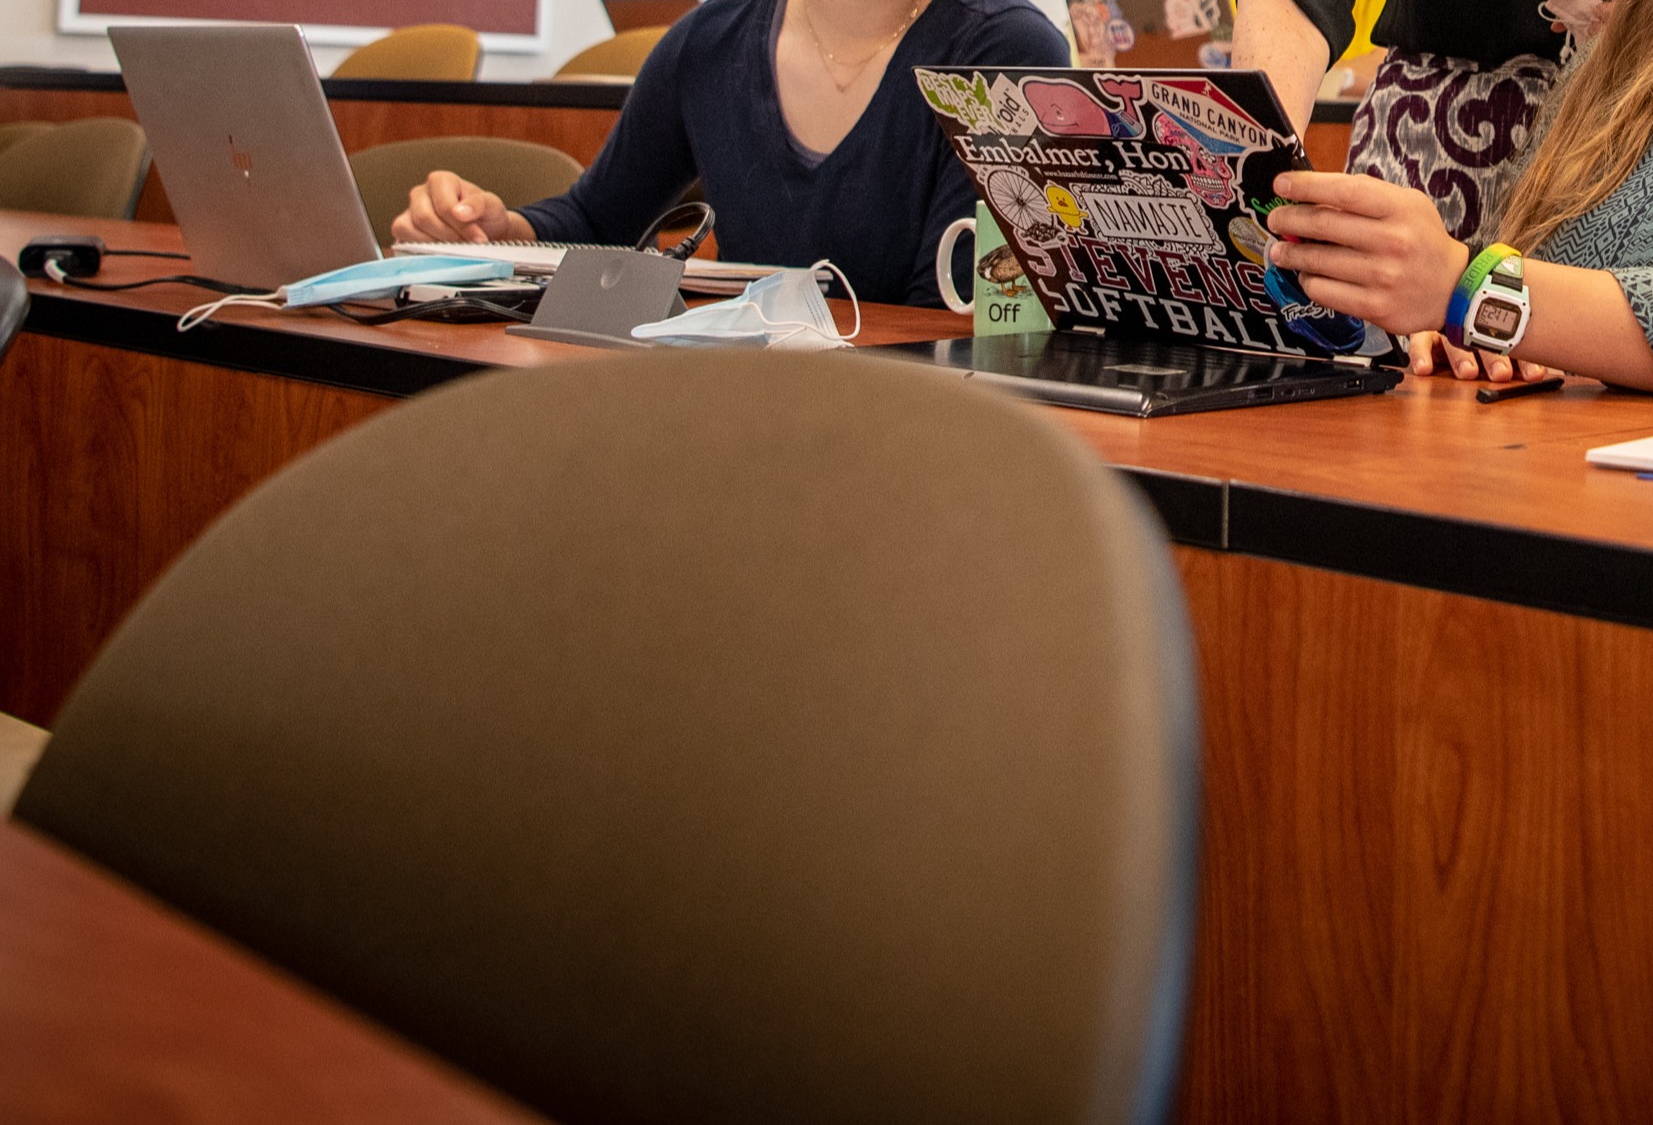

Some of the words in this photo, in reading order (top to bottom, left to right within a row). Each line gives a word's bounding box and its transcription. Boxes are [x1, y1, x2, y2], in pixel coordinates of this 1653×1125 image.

[921, 74, 956, 92] BEST
[937, 87, 981, 106] MAPS
[958, 103, 996, 125] EVER
[1151, 82, 1201, 118] GRAND
[1207, 107, 1268, 146] CANYON
[1179, 112, 1218, 134] NATIONAL
[1219, 129, 1241, 144] PARK
[953, 135, 1114, 173] Embalmer,
[1112, 141, 1191, 171] Hon
[1093, 198, 1202, 238] NAMASTE
[1014, 228, 1277, 315] STEVENS
[1463, 253, 1493, 288] PRIDE
[988, 302, 1021, 323] Off
[1037, 277, 1307, 356] SOFTBALL
